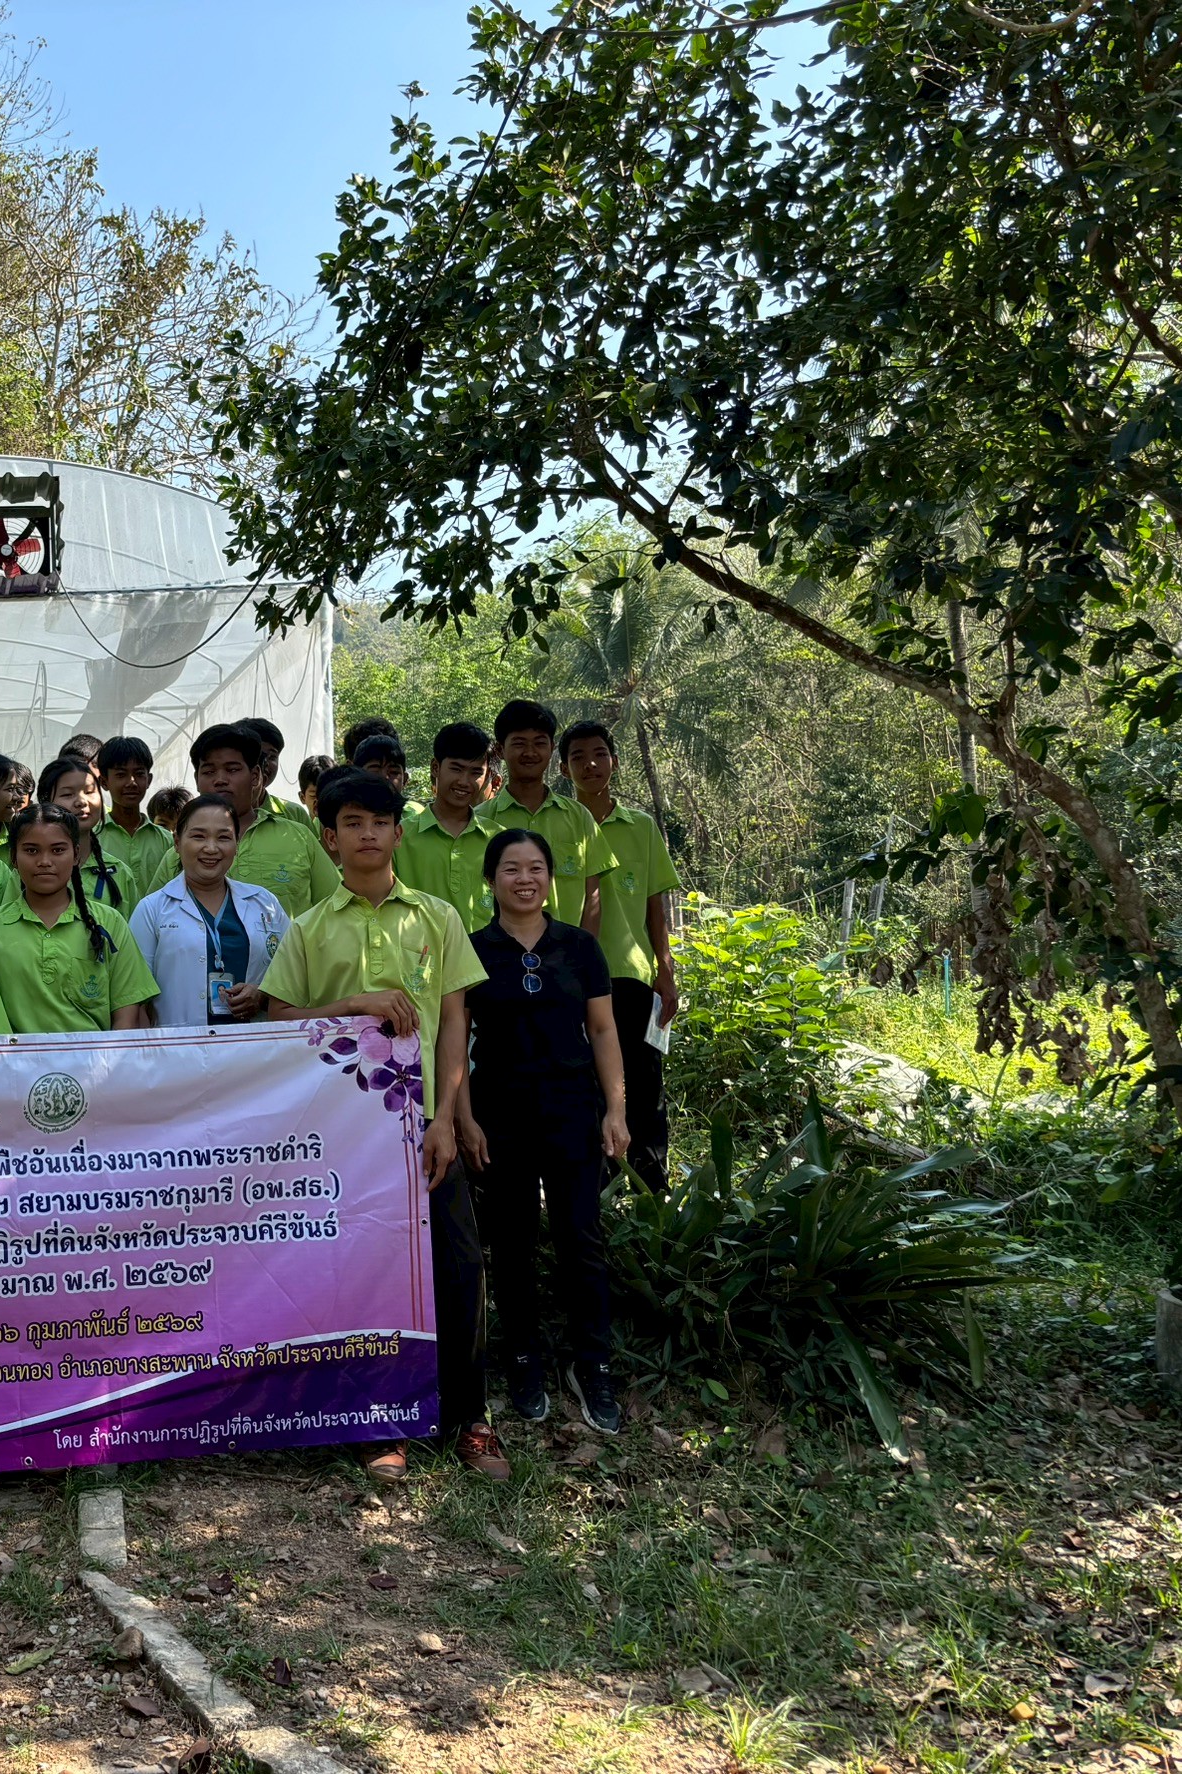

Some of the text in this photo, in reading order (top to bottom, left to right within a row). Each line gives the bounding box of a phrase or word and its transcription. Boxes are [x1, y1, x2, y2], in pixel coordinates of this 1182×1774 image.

[19, 1177, 234, 1215] สยามบรมราชกุมารี
[243, 1170, 341, 1205] (อพ.สธ.)
[64, 1270, 116, 1293] พ.ศ.
[124, 1256, 213, 1287] ๒๕๖๙
[28, 1309, 130, 1348] กุมภาพันธ์
[136, 1311, 203, 1335] ๒๕๖๙
[60, 1352, 212, 1379] อำเภอบางสะพาน
[218, 1331, 401, 1370] จังหวัดประจวบคีรีขันธ์
[54, 1402, 421, 1450] โดย สำนักงานการปฏิรูปที่ดินจังหวัดประจวบคีรีขันธ์
